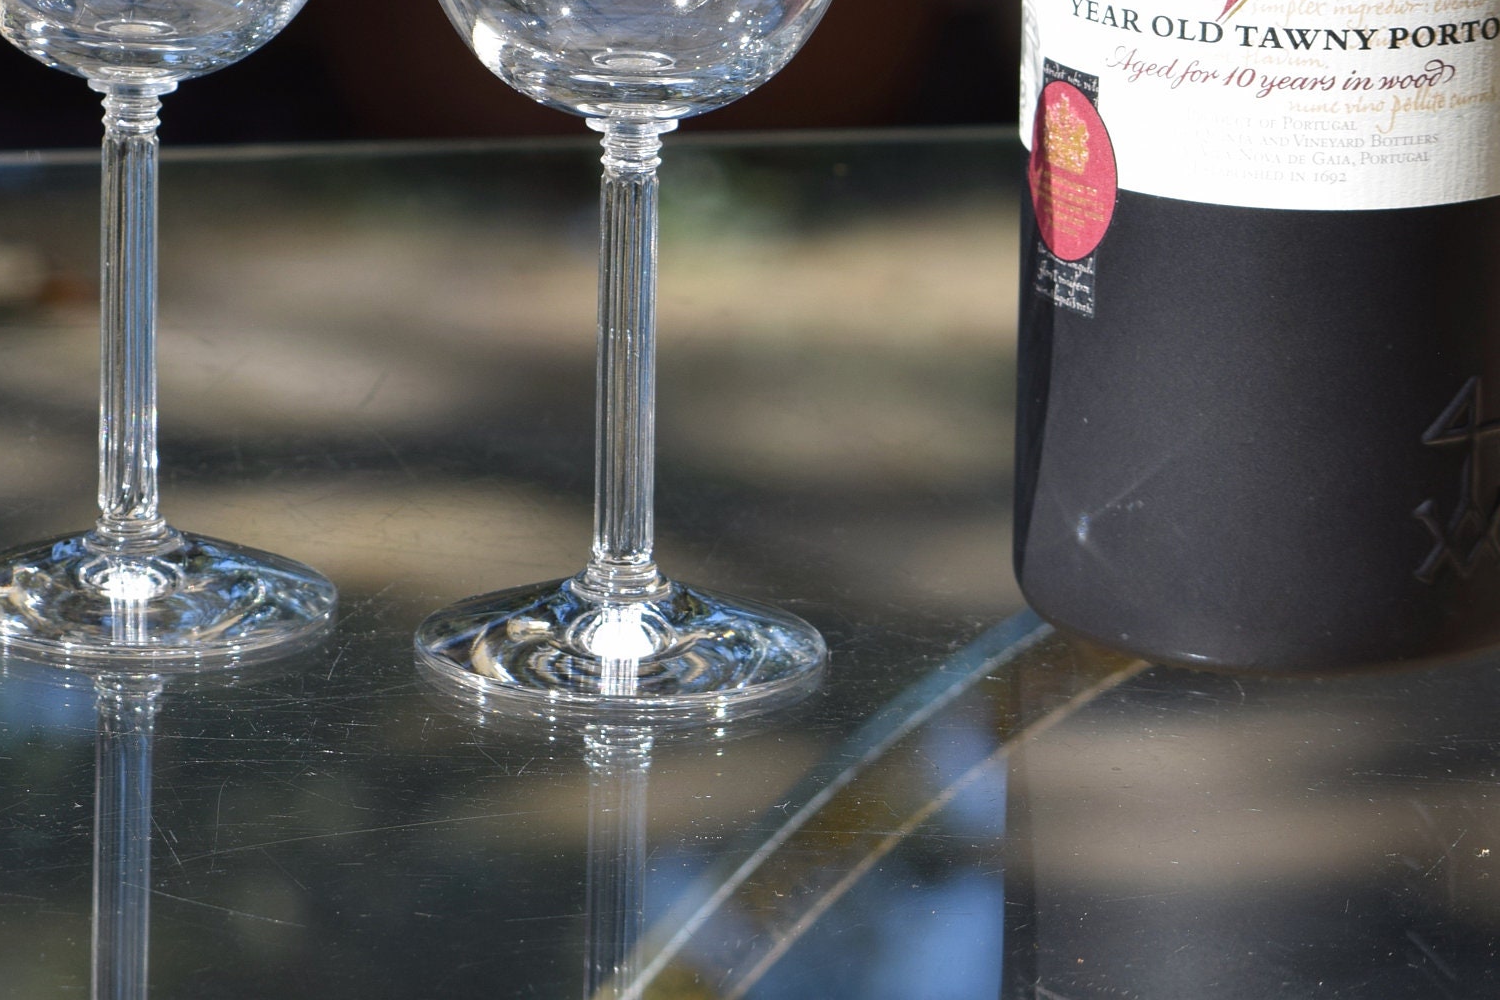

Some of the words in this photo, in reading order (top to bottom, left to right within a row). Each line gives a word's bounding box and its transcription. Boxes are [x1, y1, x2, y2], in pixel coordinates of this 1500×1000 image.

[1151, 15, 1225, 44] OLD
[1235, 24, 1379, 51] TAWNY
[1387, 16, 1500, 50] PORTO
[1105, 45, 1181, 83] Aged
[1170, 59, 1221, 90] for
[1222, 65, 1257, 88] 10
[1256, 72, 1336, 99] years
[1341, 69, 1375, 91] in
[1377, 58, 1456, 91] wood
